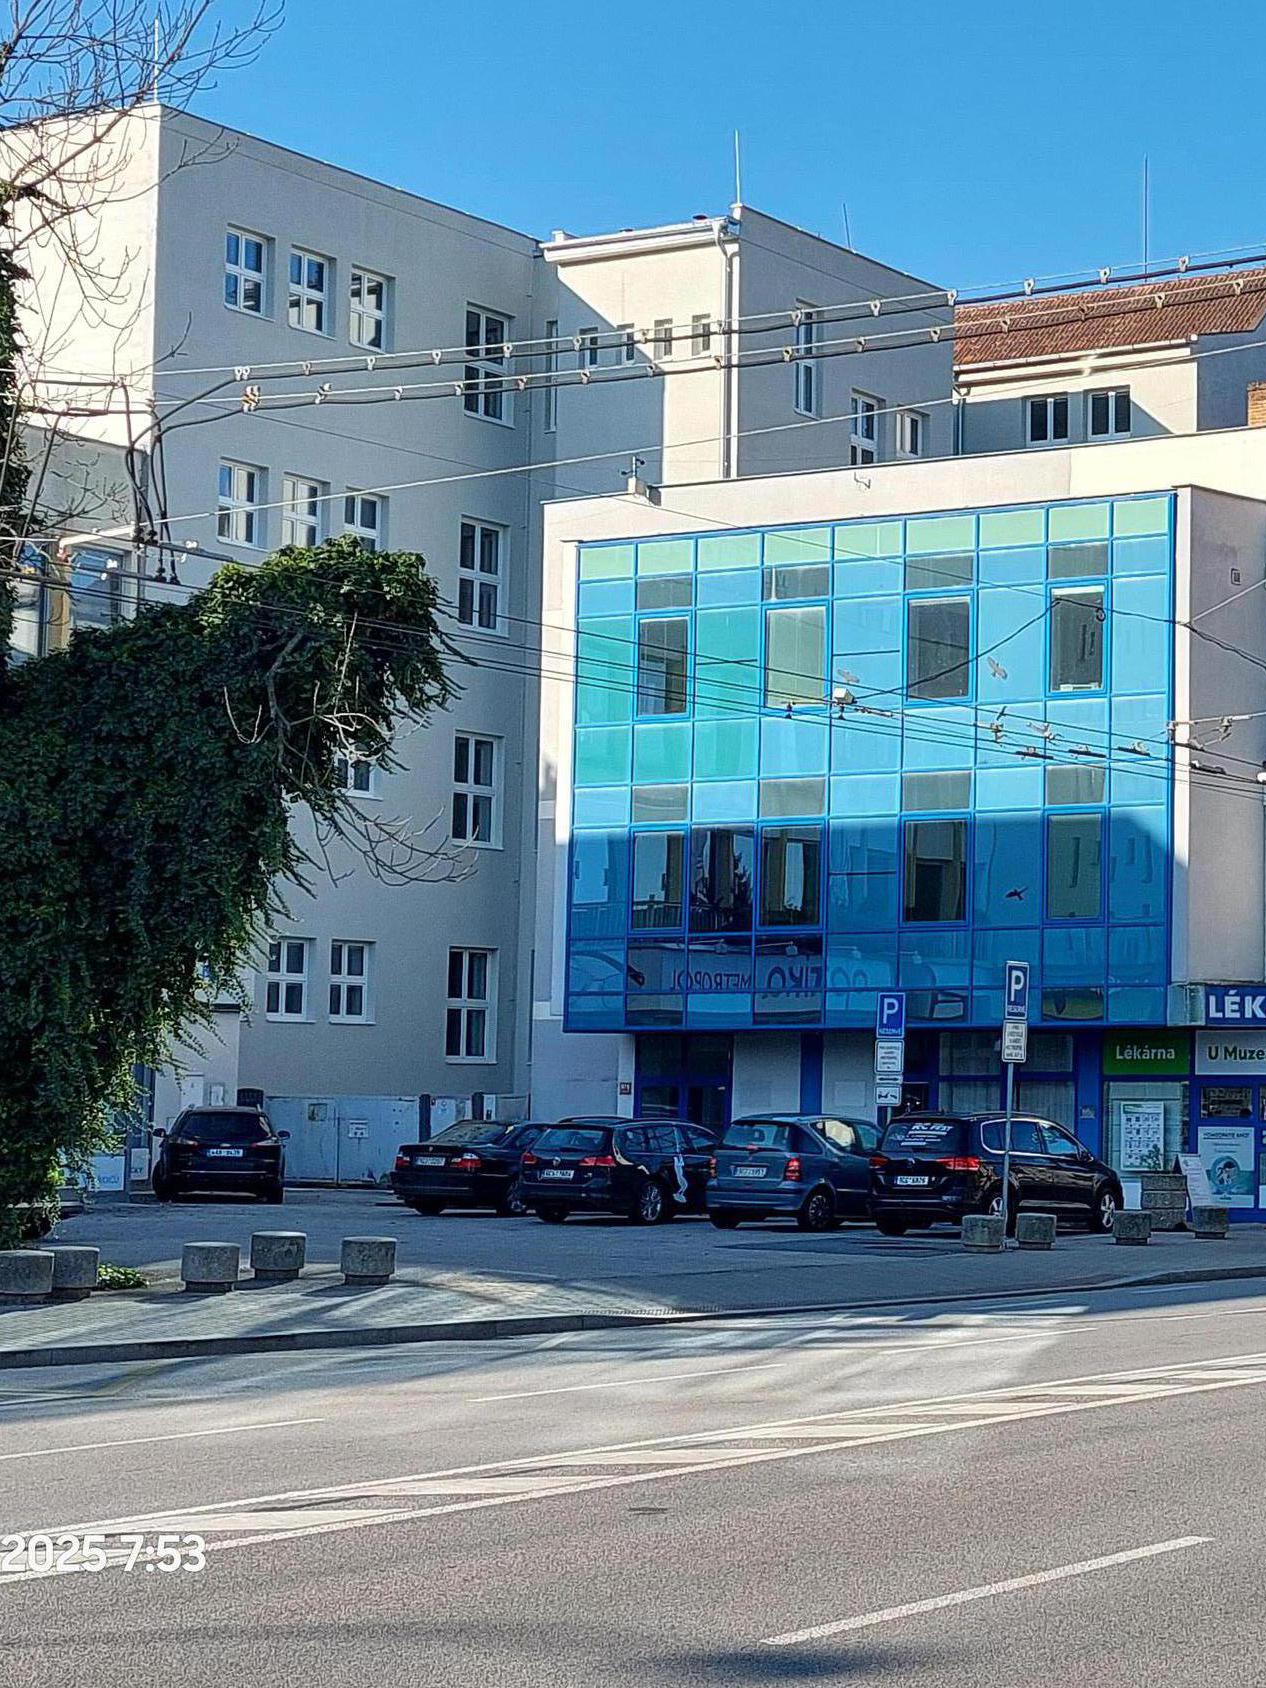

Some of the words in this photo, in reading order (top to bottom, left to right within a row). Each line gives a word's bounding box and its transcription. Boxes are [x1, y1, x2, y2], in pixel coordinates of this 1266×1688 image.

[1010, 969, 1025, 1002] P
[883, 997, 899, 1025] P
[1115, 1045, 1175, 1060] Lékárna
[1207, 1046, 1219, 1061] U
